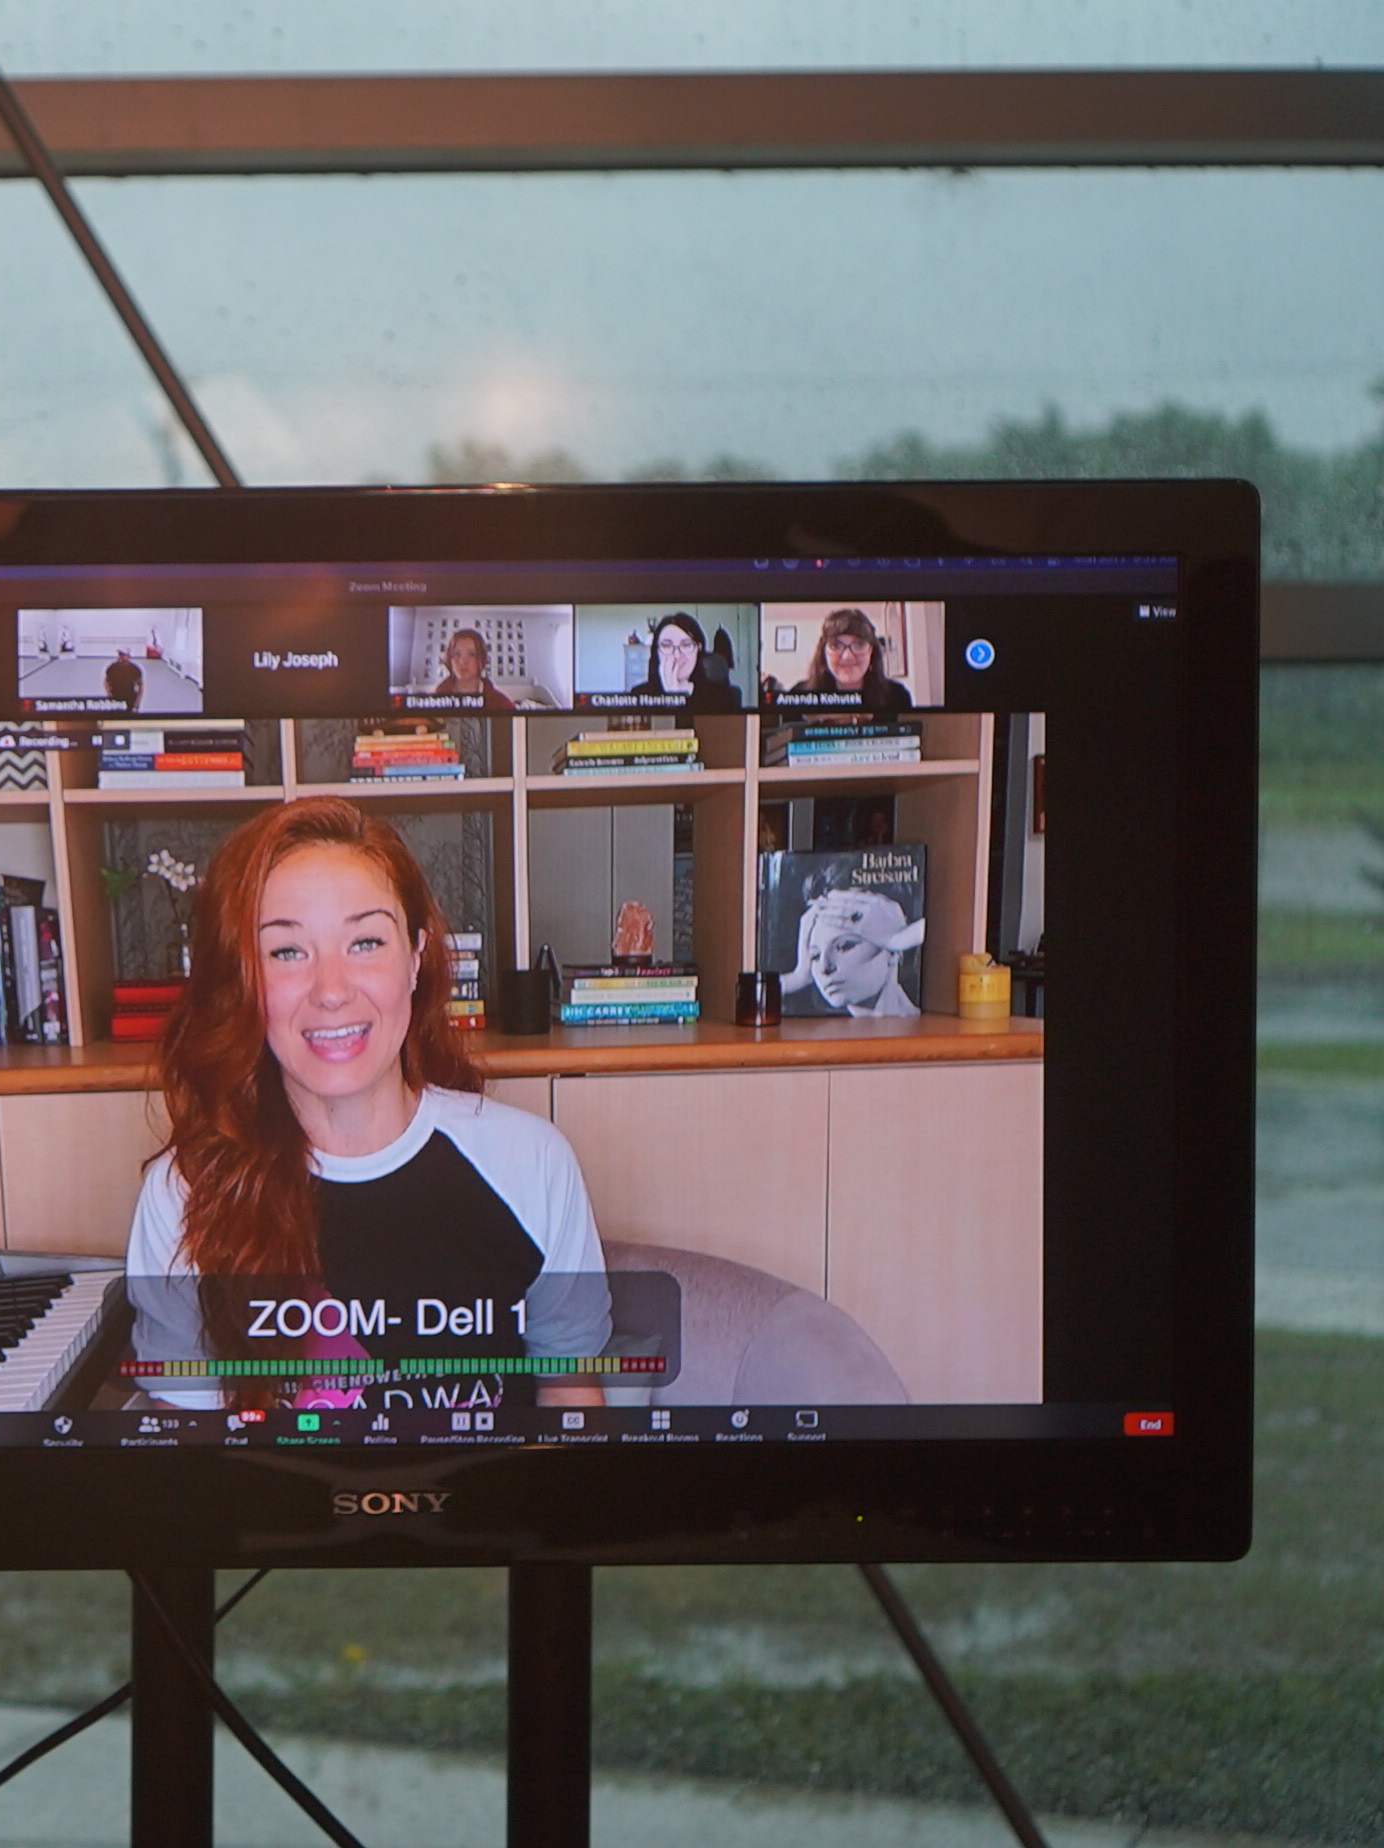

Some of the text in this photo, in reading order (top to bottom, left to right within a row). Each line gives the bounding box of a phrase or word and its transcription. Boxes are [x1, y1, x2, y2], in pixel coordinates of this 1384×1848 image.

[382, 581, 427, 593] Meeting
[1152, 605, 1177, 618] View
[253, 651, 339, 671] Lily Joseph
[405, 696, 484, 708] Elizabeth's iPad
[591, 695, 638, 707] Charlotte
[776, 692, 862, 706] Amanda Kohutek
[35, 700, 85, 712] Samantha
[862, 851, 913, 869] Barbra
[851, 865, 919, 885] Streisand
[247, 1298, 527, 1338] ZOOM- Dell 1
[1139, 1418, 1163, 1431] End
[332, 1492, 452, 1515] SONY
